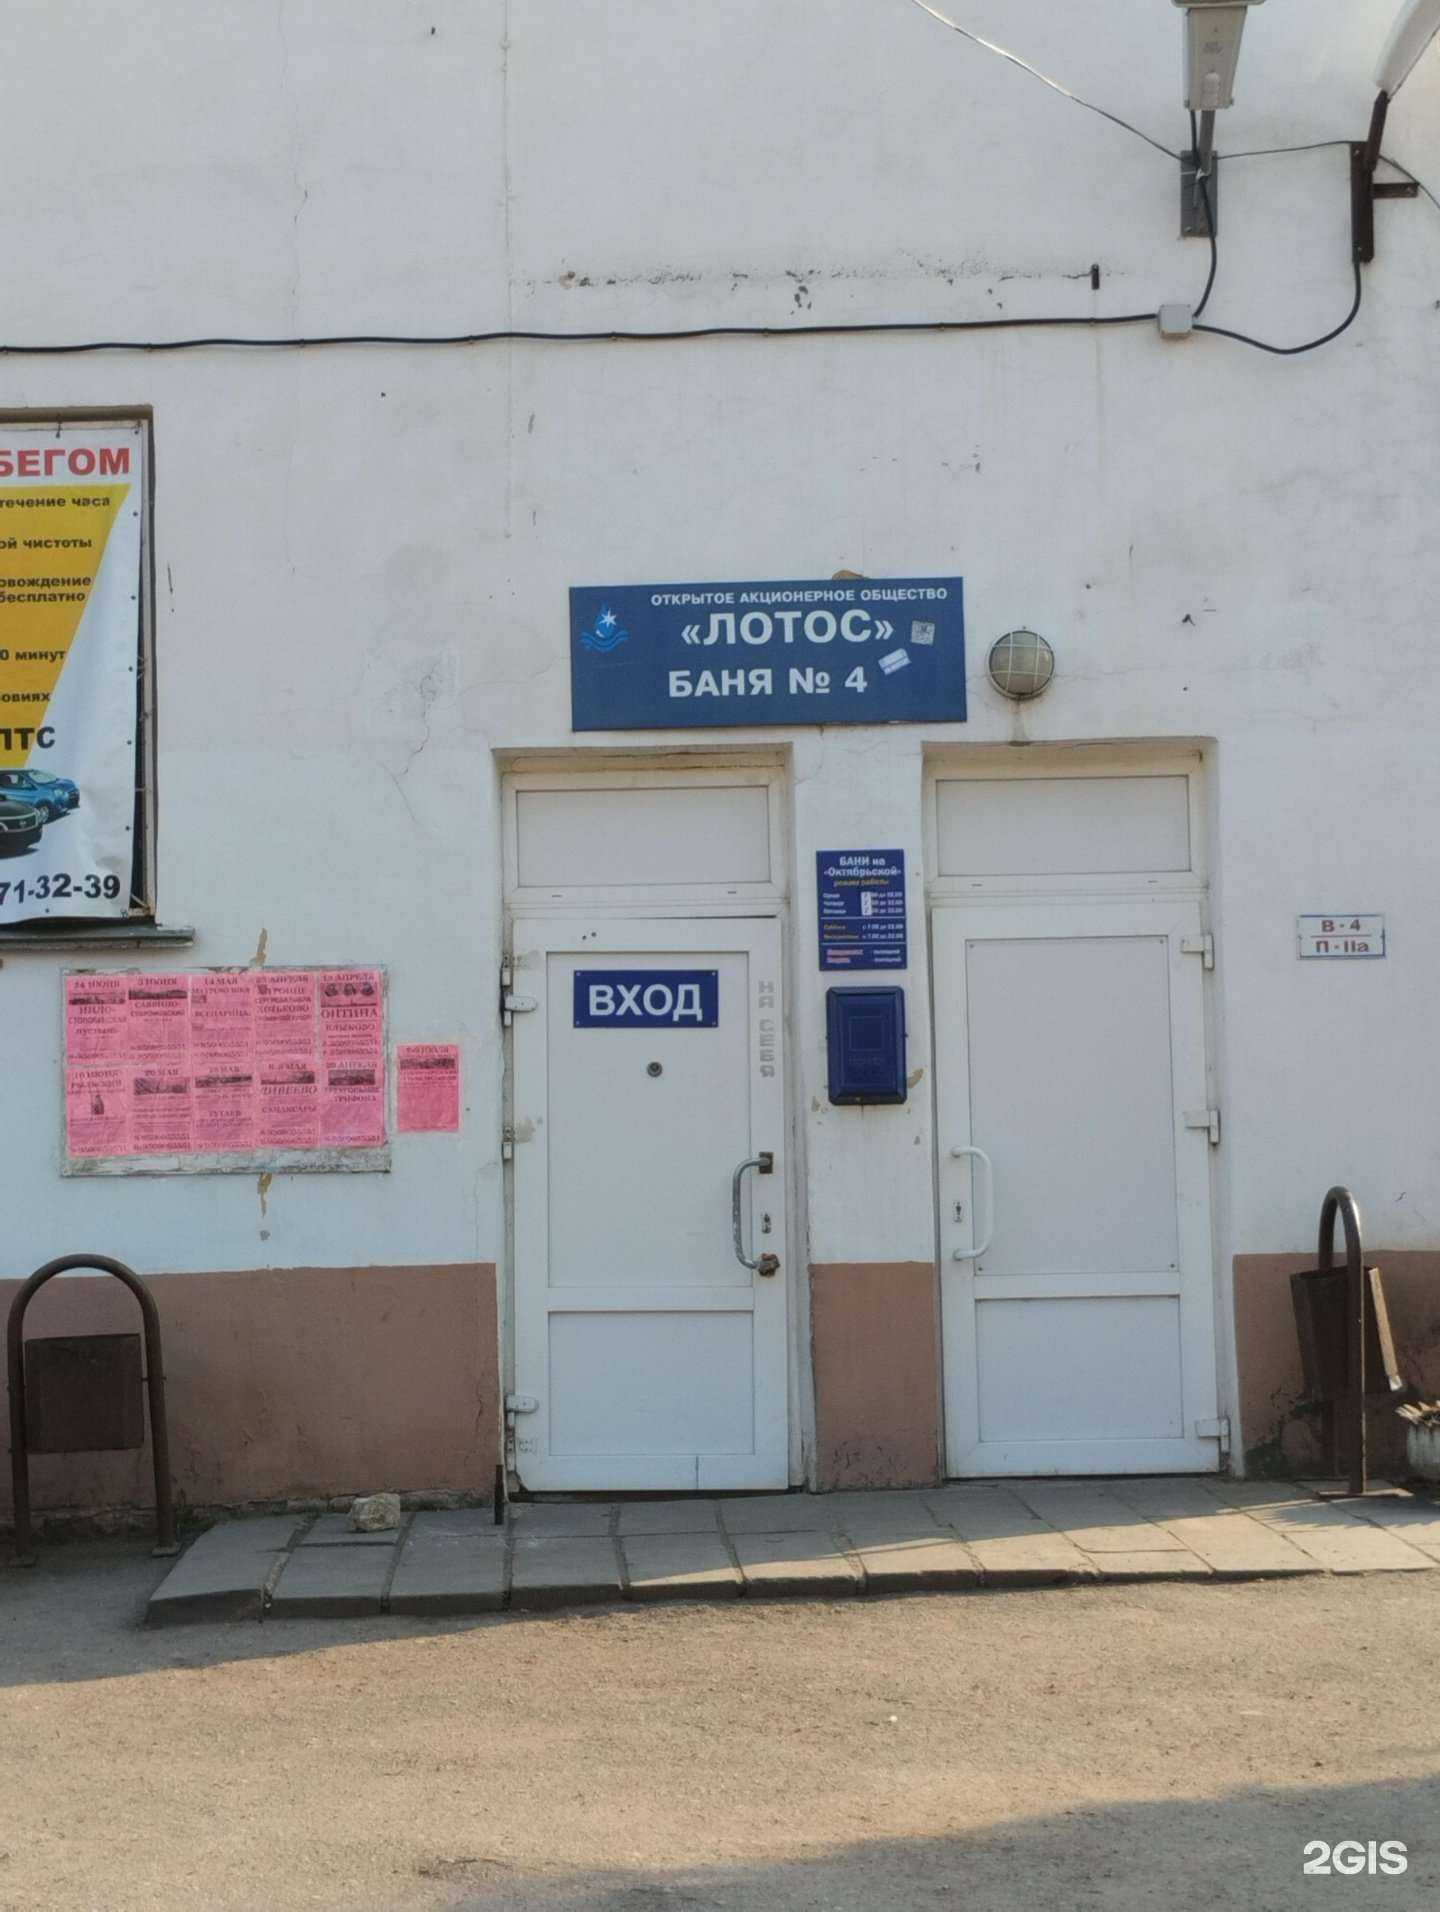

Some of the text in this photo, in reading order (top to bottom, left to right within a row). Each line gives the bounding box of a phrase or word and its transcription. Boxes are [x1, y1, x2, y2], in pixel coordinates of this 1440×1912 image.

[72, 497, 110, 507] часа
[23, 537, 92, 549] чистоты
[651, 587, 948, 606] ОТКРЫТОЕ АКЦИОНЕРНОЕ ОБЩЕСТВО
[681, 609, 894, 645] «ЛОТОС»
[15, 650, 66, 663] минут
[668, 665, 868, 698] БАНЯ № 4
[839, 856, 870, 867] БАНИ
[588, 984, 703, 1022] ВХОД
